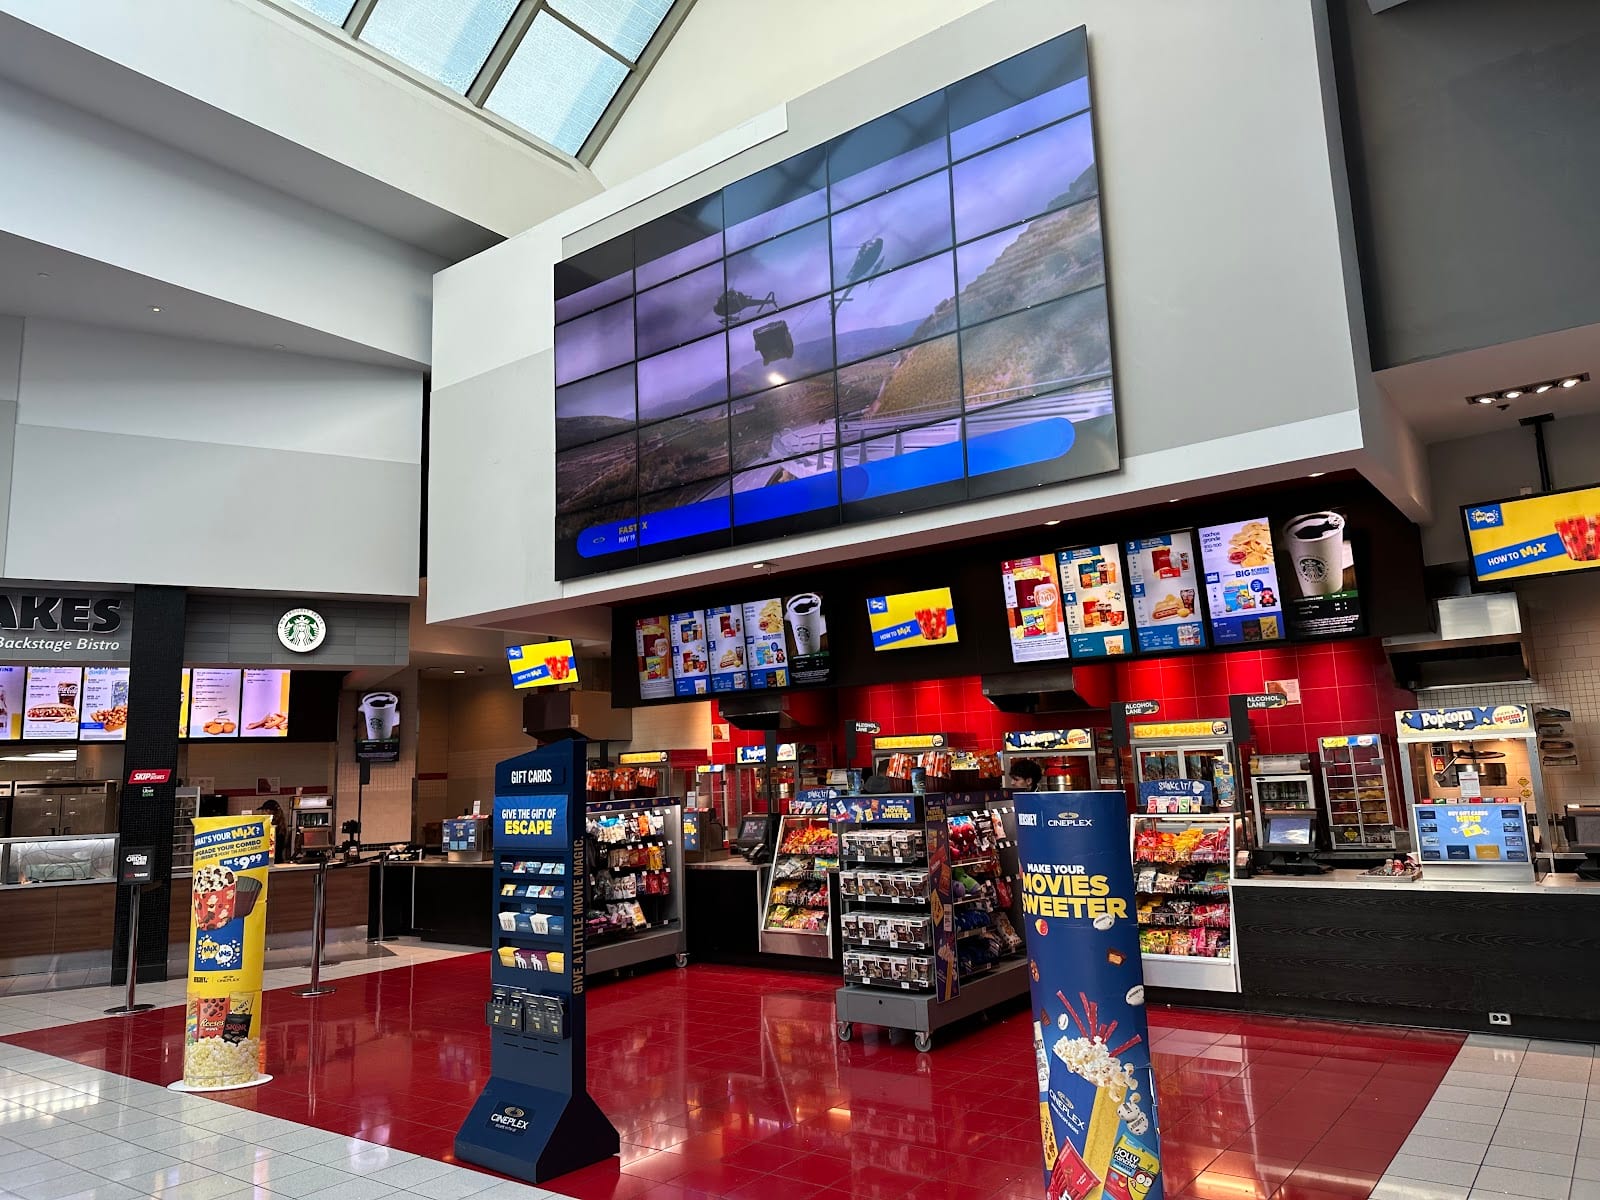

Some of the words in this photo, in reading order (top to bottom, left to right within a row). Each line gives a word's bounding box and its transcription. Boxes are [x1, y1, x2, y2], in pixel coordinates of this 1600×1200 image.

[618, 525, 638, 535] FAST
[642, 521, 648, 530] X
[1129, 542, 1135, 550] 3
[1061, 552, 1067, 560] 2
[1488, 554, 1509, 566] HOW
[1509, 552, 1519, 561] TO
[1004, 561, 1010, 569] 1
[1135, 585, 1141, 593] 5
[0, 637, 72, 652] Backstage
[76, 638, 119, 650] Bistro
[1420, 710, 1473, 727] Popcorn
[1020, 733, 1054, 746] Popcorn
[511, 770, 527, 784] GIFT
[528, 769, 552, 783] CARDS
[502, 809, 516, 819] GIVE
[518, 809, 531, 819] THE
[531, 809, 546, 819] GIFT
[547, 808, 556, 818] OF
[505, 820, 552, 835] ESCAPE
[1047, 819, 1092, 827] CINEPLEX
[212, 832, 231, 842] YOUR
[236, 839, 261, 848] COMBO
[574, 835, 584, 876] MAGIC.
[1027, 864, 1051, 873] MAKE
[1053, 865, 1085, 874] YOUR
[1023, 872, 1110, 896] MOVIES
[573, 878, 583, 915] MOVIE
[573, 917, 583, 955] LITTLE
[573, 955, 583, 964] A
[573, 967, 584, 994] GIVE
[1049, 1089, 1085, 1130] CINEPLEX
[491, 1113, 529, 1129] CINEPLEX
[1115, 1148, 1139, 1164] JOLLY
